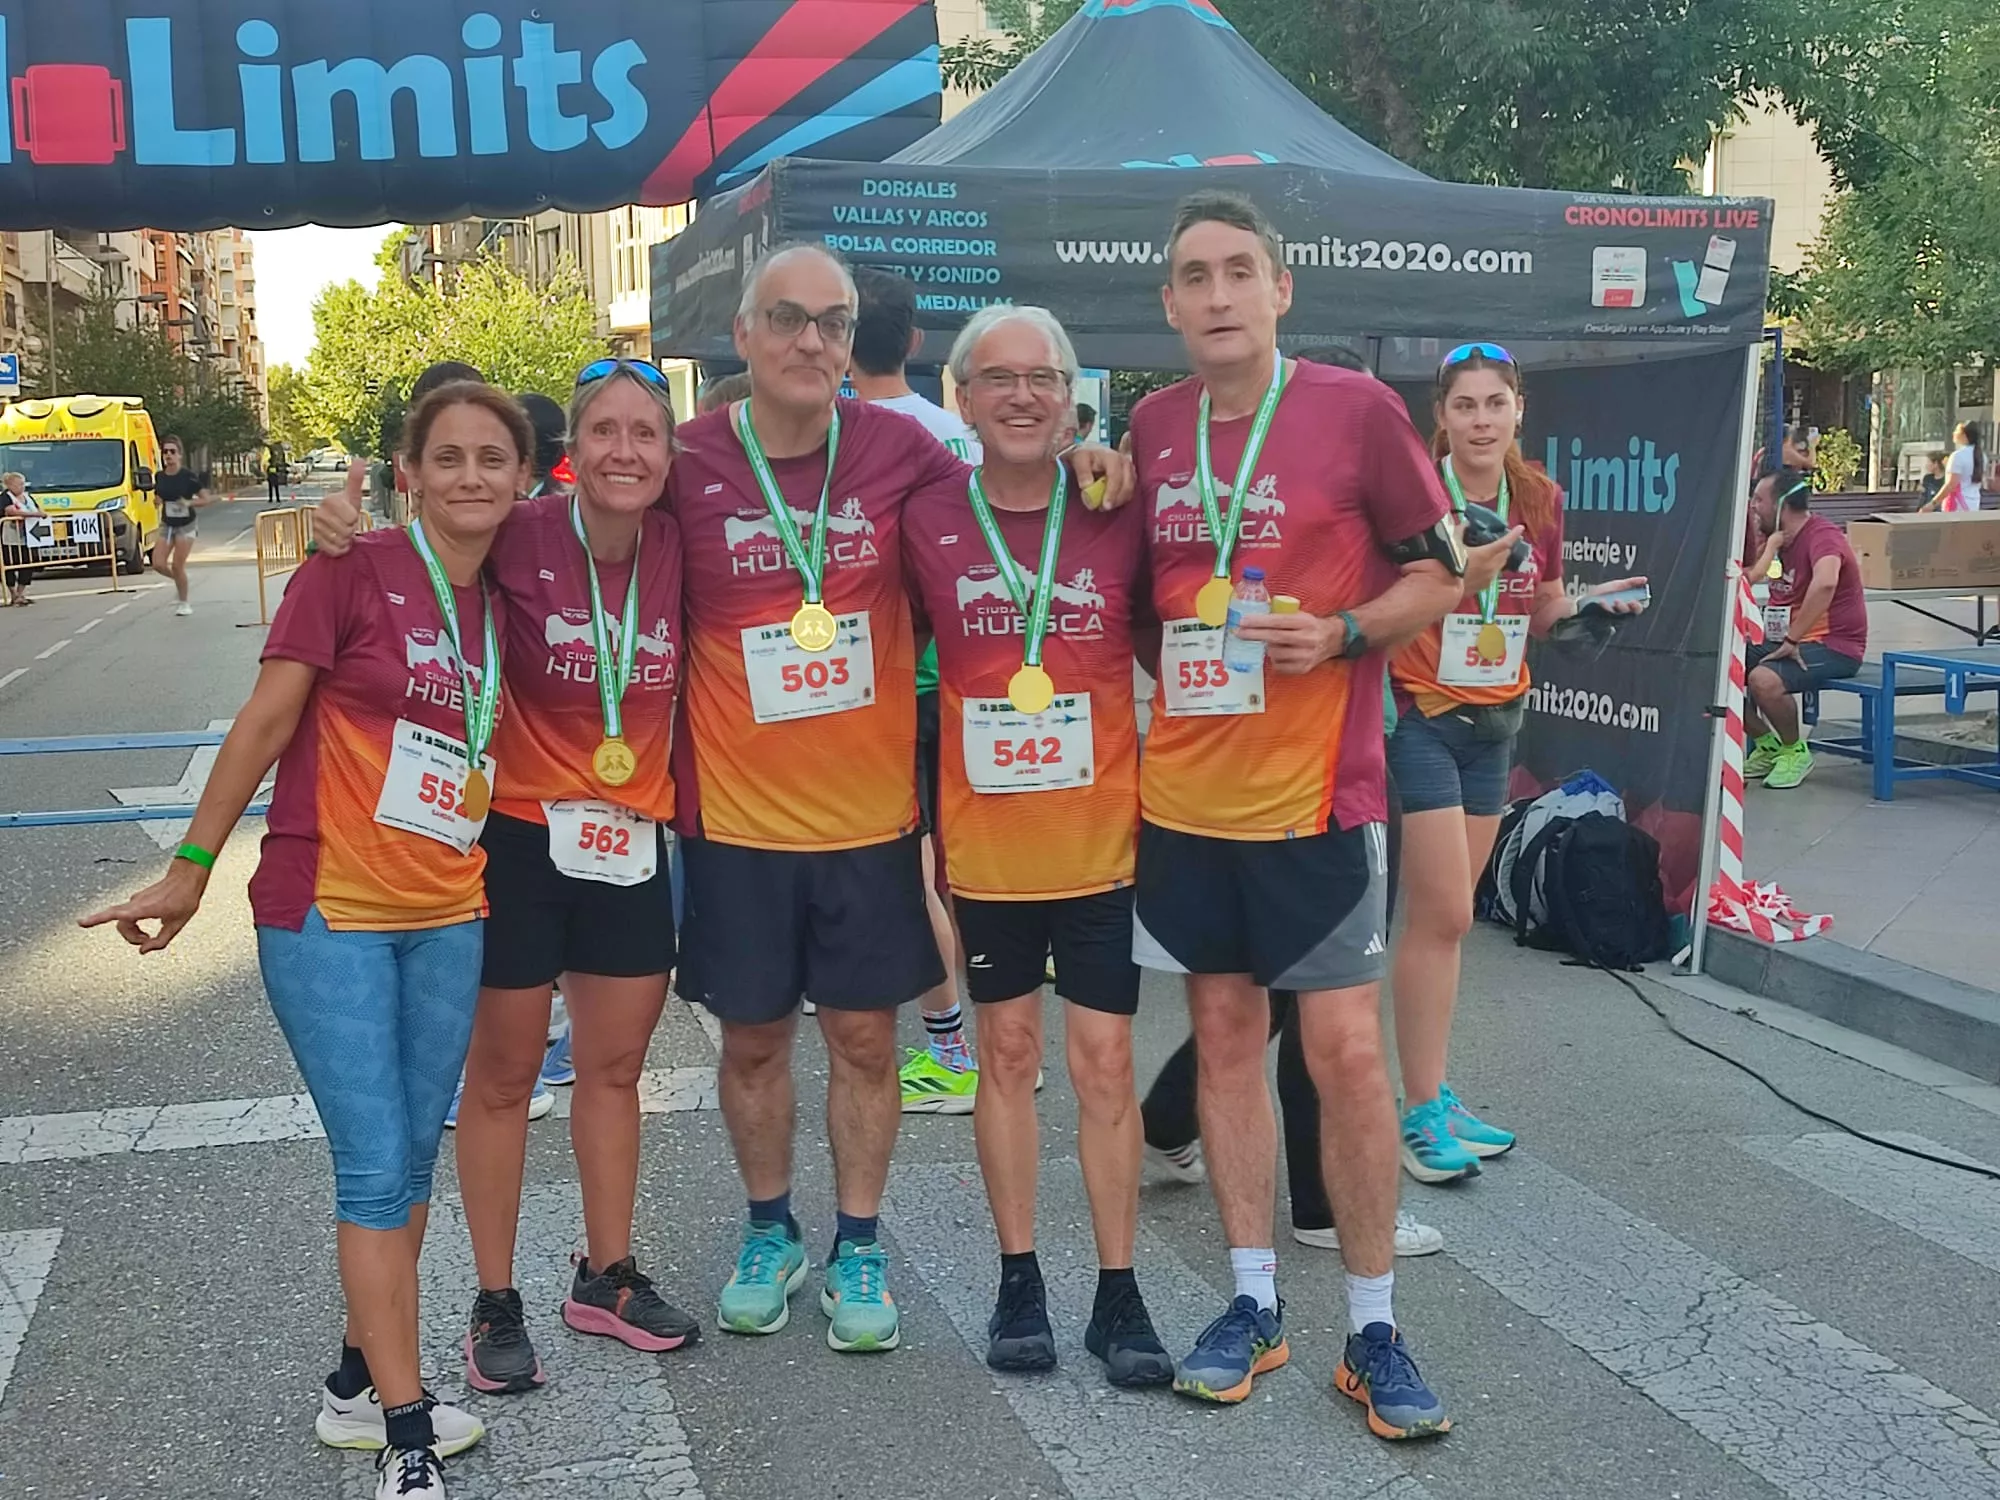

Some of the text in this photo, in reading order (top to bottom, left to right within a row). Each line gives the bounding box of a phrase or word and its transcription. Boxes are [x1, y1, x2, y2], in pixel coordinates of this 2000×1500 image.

[126, 13, 648, 165] Limits
[863, 179, 957, 201] DORSALES
[833, 206, 988, 228] VALLAS Y ARCOS
[1565, 206, 1760, 229] CRONOLIMITS LIVE
[824, 234, 997, 256] BOLSA CORREDOR
[911, 266, 923, 282] Y
[928, 266, 1000, 284] SONIDO
[1547, 435, 1680, 514] Limits
[74, 517, 97, 535] 10K
[1153, 520, 1282, 544] HUECA
[1625, 544, 1637, 571] y
[1498, 577, 1534, 593] SCA
[546, 655, 675, 684] HUSCA
[781, 657, 850, 693] 503
[1178, 660, 1230, 689] 533
[1949, 673, 1959, 698] 1
[993, 737, 1063, 767] 542
[578, 821, 631, 856] 562
[387, 1400, 424, 1418] CRIVIT
